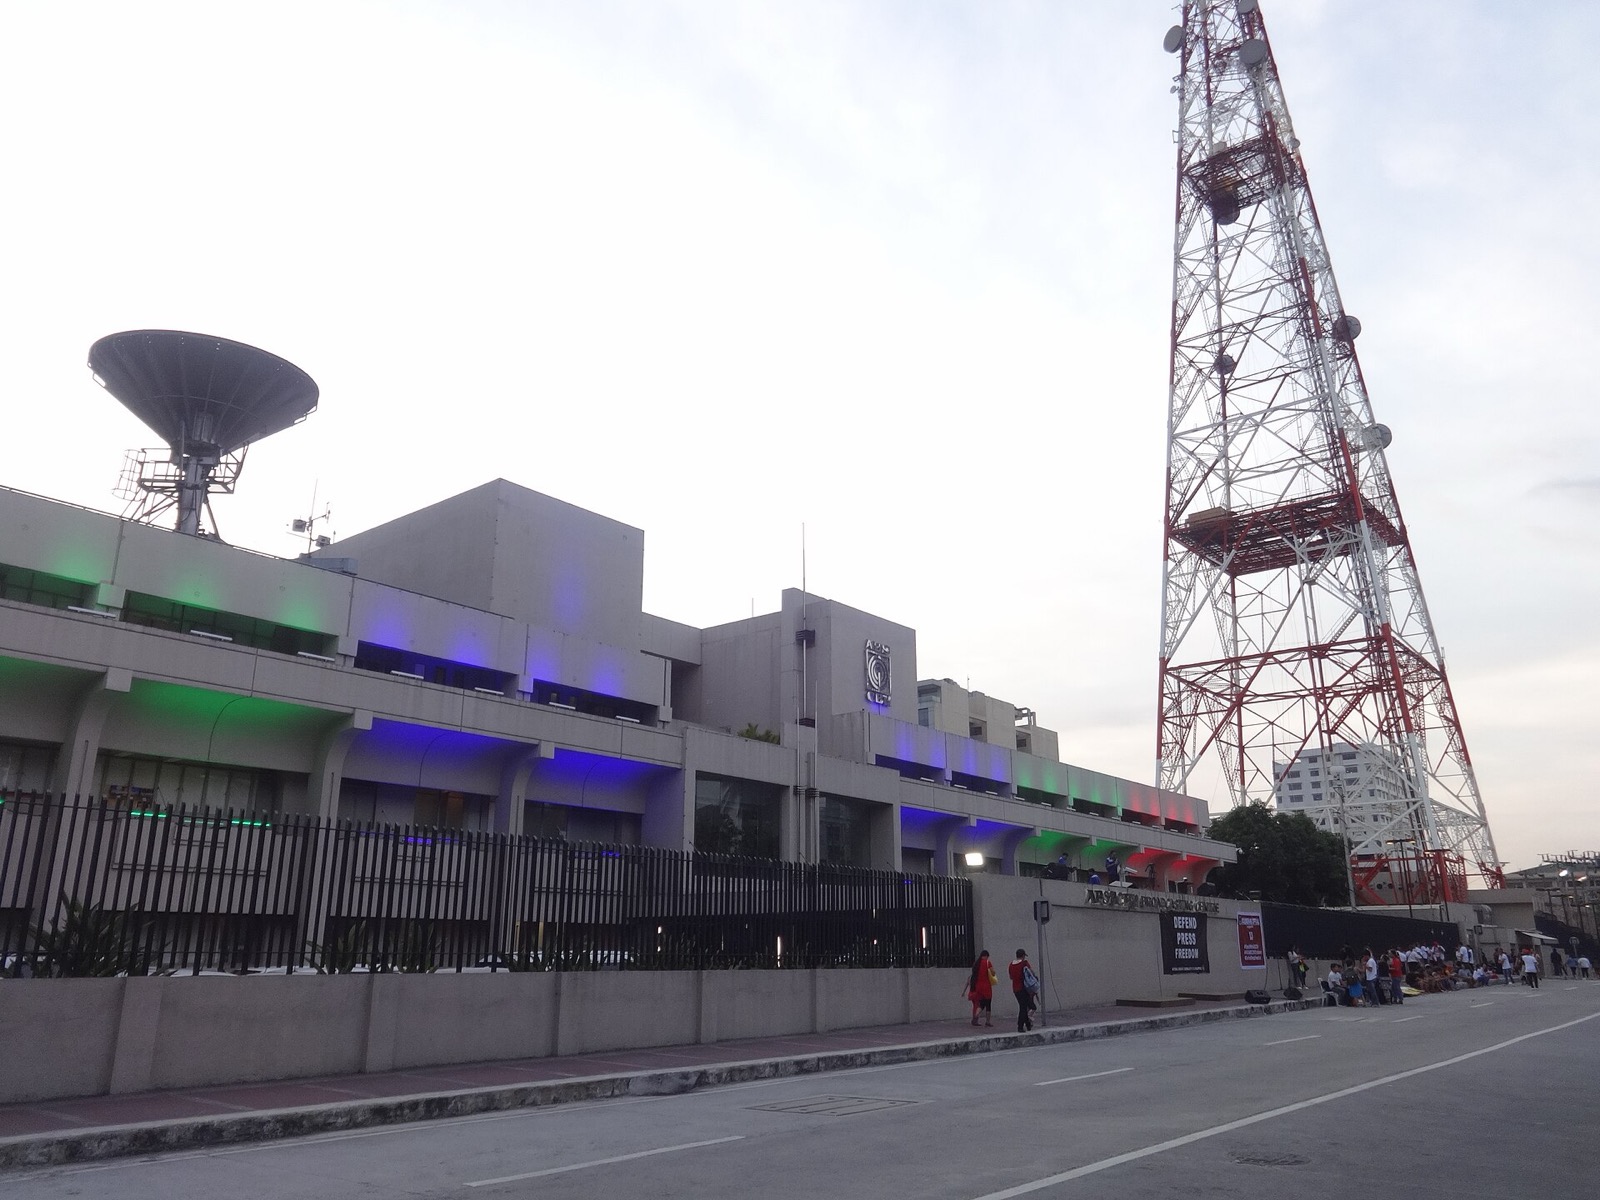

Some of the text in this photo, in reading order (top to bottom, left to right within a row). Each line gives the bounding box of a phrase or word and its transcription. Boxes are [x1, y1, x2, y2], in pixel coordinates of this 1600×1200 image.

[1173, 916, 1197, 929] DEFEND
[1176, 932, 1197, 946] PRESS
[1174, 948, 1199, 959] FREEDOM
